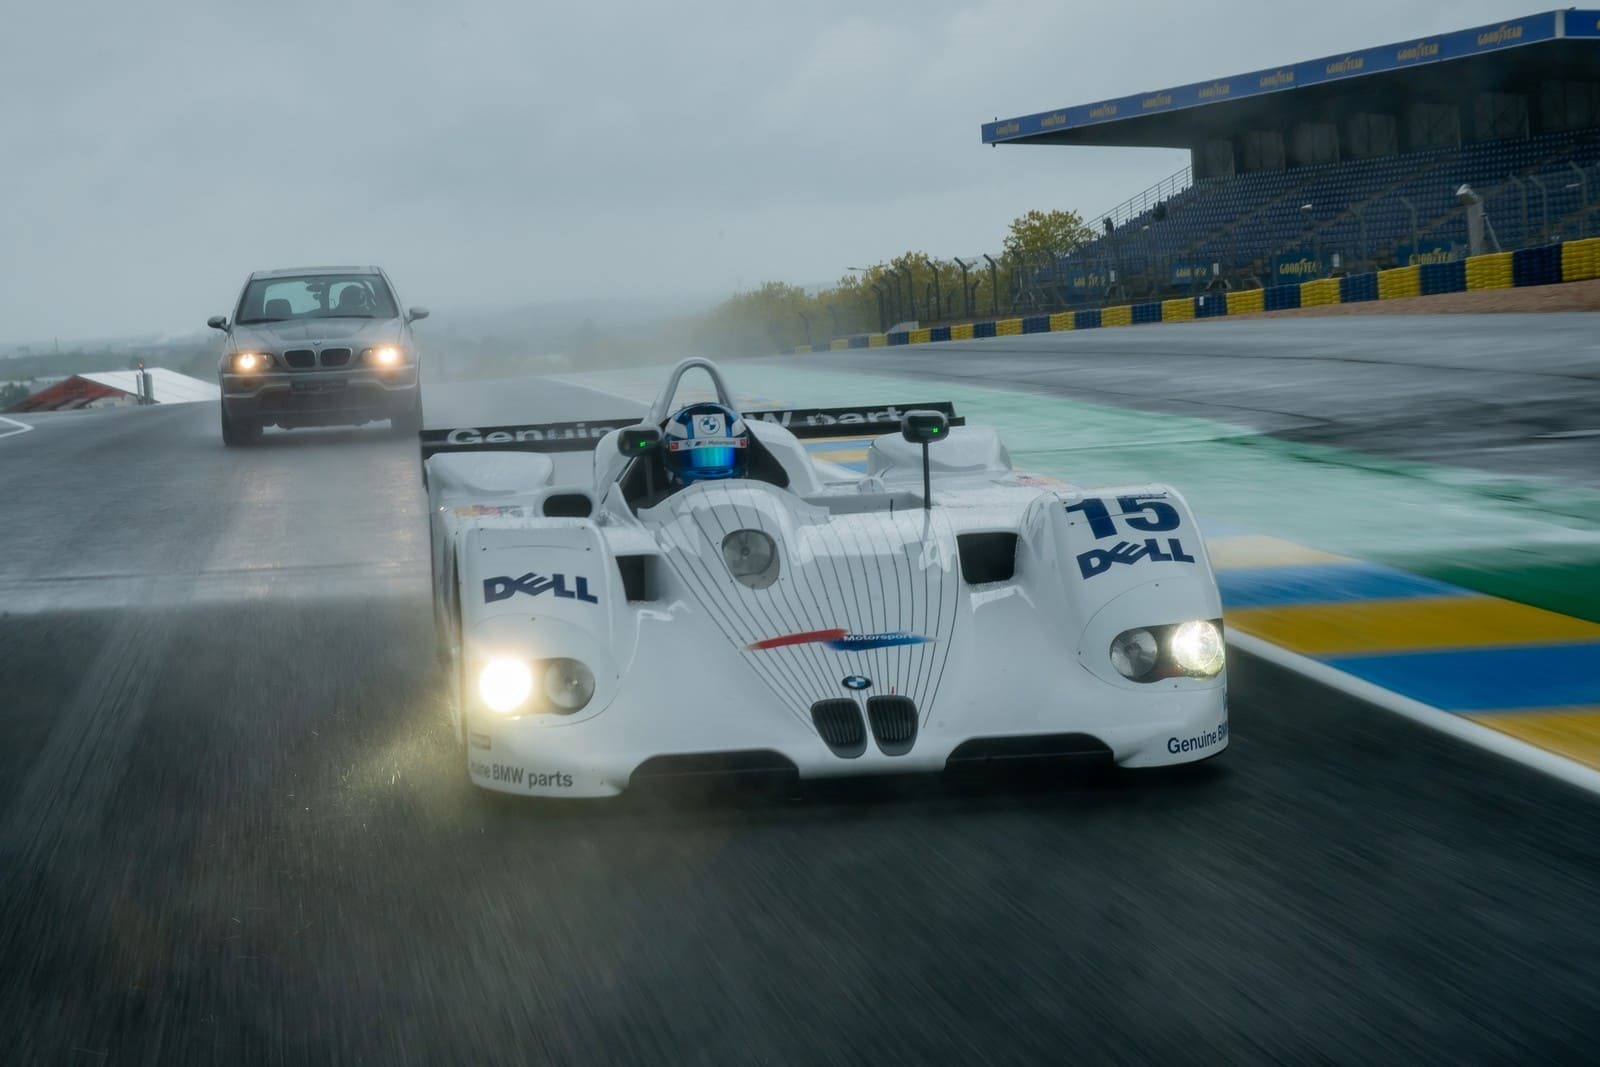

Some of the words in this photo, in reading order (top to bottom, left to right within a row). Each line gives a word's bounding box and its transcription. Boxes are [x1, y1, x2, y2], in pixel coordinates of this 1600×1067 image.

[1477, 25, 1522, 46] GOODYEAR
[1397, 42, 1438, 61] GOODYEAR
[447, 423, 617, 445] Genuin
[806, 407, 904, 426] part
[1065, 494, 1181, 540] 15
[1076, 538, 1195, 580] DELL
[483, 572, 598, 603] DELL
[843, 633, 912, 641] Motorsport
[1167, 730, 1217, 754] Genuine
[492, 763, 524, 784] BMW
[528, 771, 573, 789] parts
